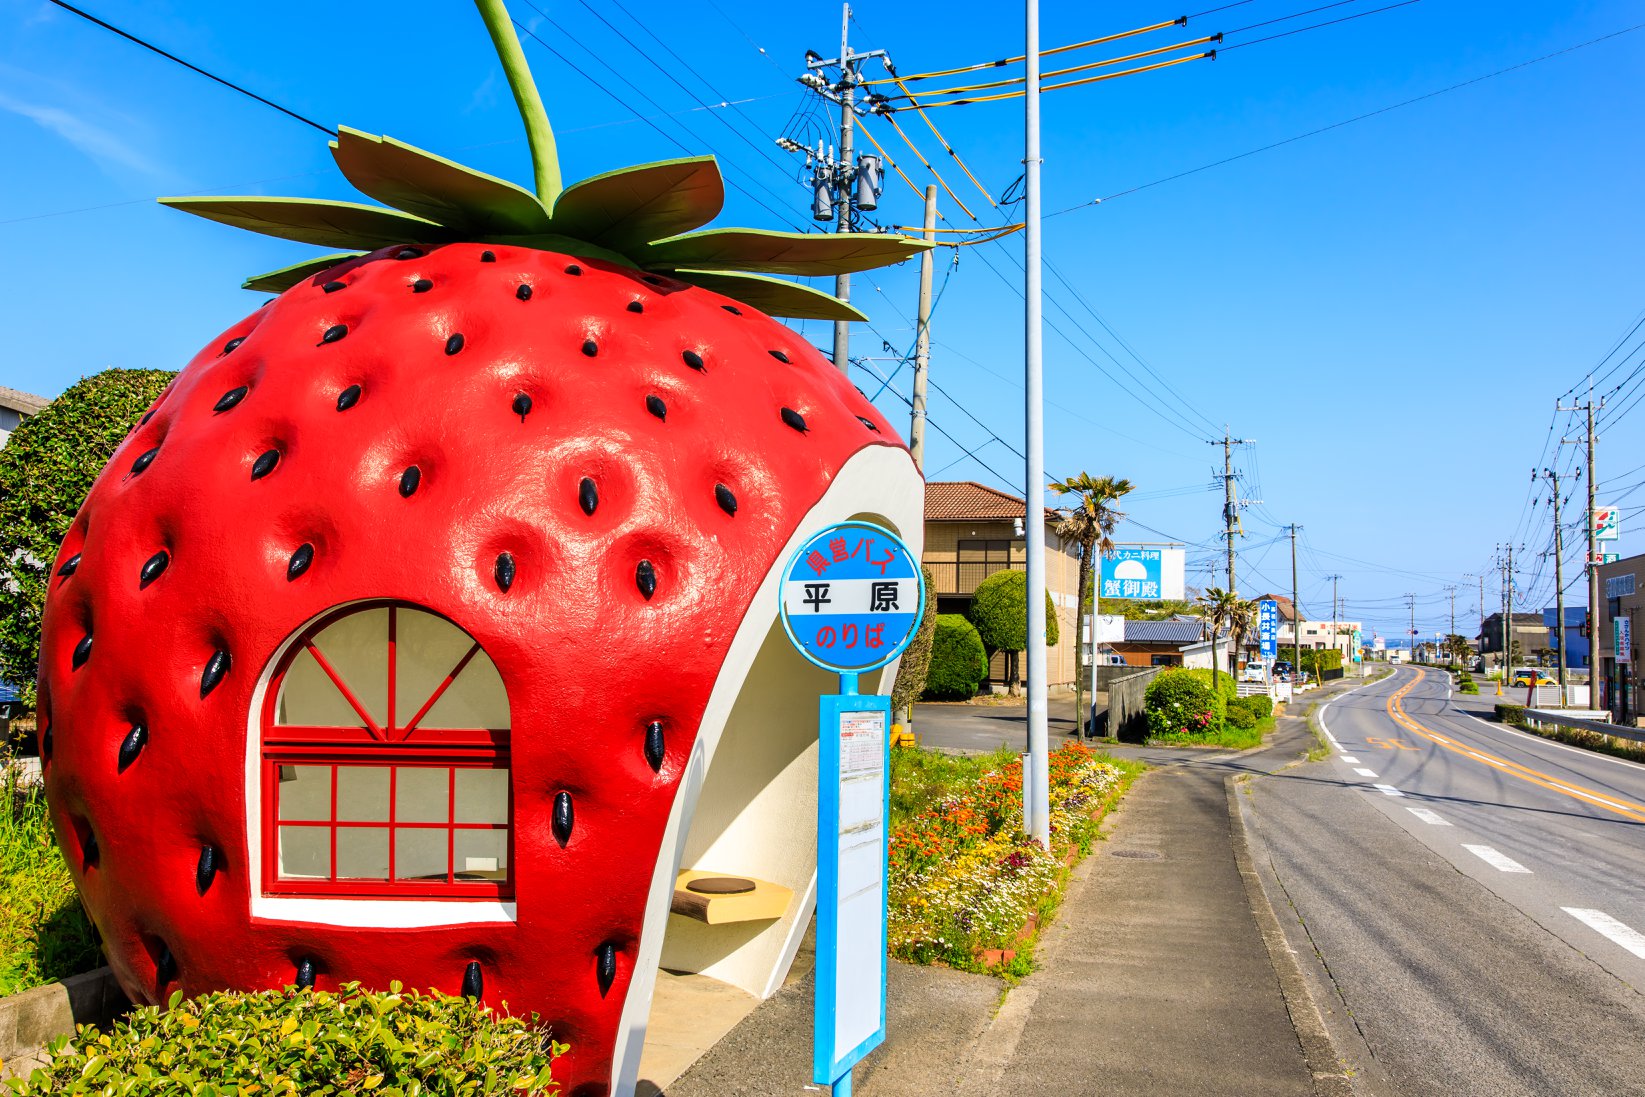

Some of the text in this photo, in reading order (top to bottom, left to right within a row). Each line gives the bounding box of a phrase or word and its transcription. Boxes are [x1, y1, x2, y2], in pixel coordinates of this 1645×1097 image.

[806, 536, 895, 576] 県営バス
[802, 581, 900, 613] 平原
[1104, 579, 1158, 597] 蟹御殿
[816, 622, 885, 649] のりば
[1261, 603, 1270, 650] 小長井斎場
